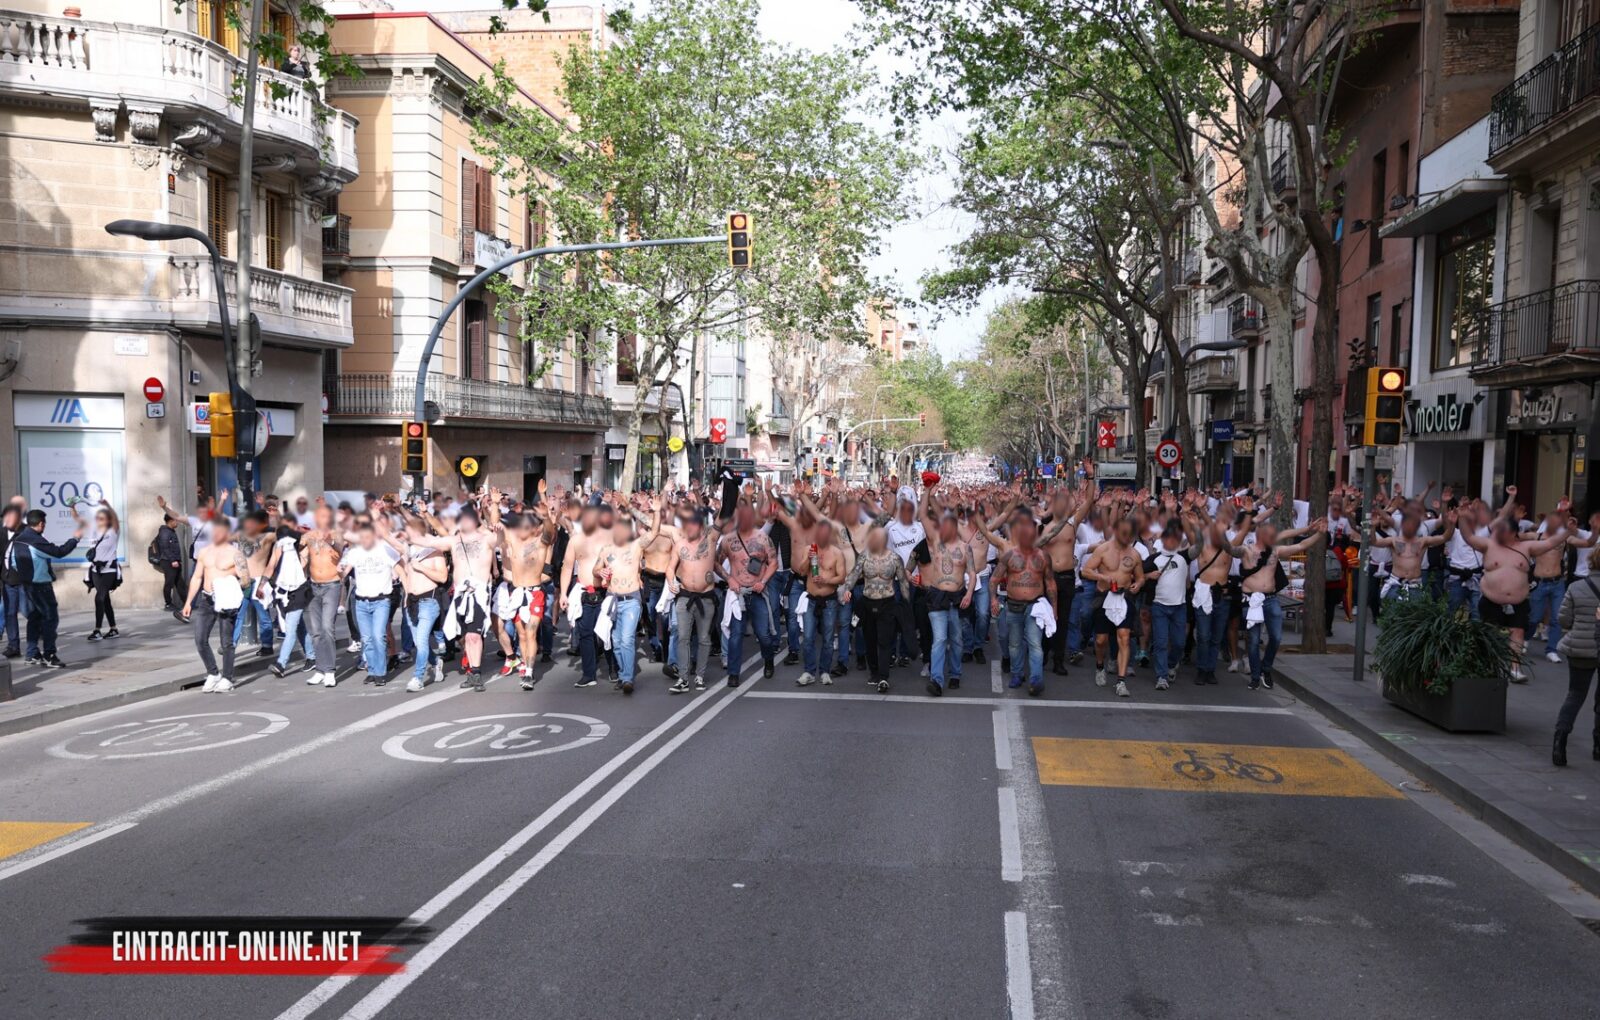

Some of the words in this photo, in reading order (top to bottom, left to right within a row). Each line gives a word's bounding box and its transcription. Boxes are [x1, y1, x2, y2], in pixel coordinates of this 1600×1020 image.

[1162, 448, 1177, 458] 30
[40, 481, 103, 508] 300
[434, 724, 563, 749] 30
